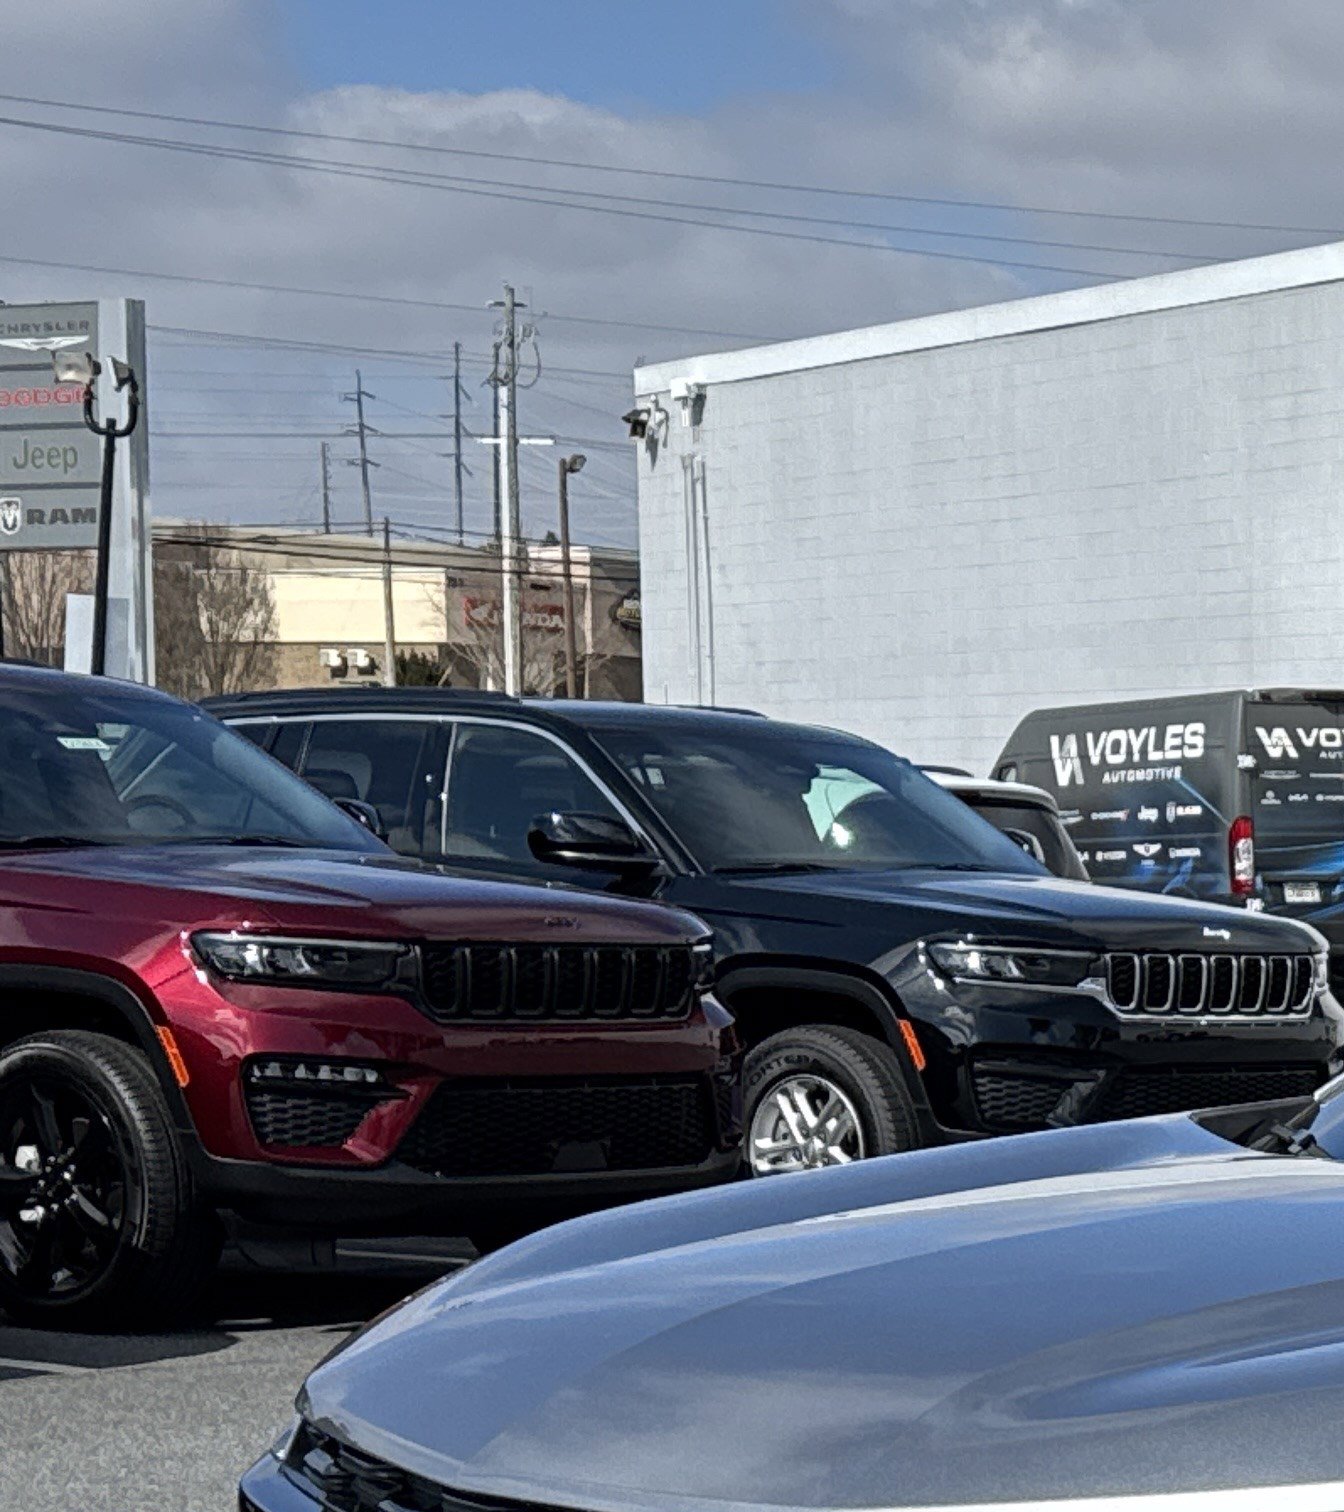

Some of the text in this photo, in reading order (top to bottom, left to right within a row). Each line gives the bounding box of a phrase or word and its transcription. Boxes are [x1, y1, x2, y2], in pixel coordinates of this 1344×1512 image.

[12, 438, 78, 475] Jeep
[26, 507, 97, 525] RAM
[1086, 722, 1206, 766] VOYLES
[1102, 765, 1182, 784] AUTOMOTIVE
